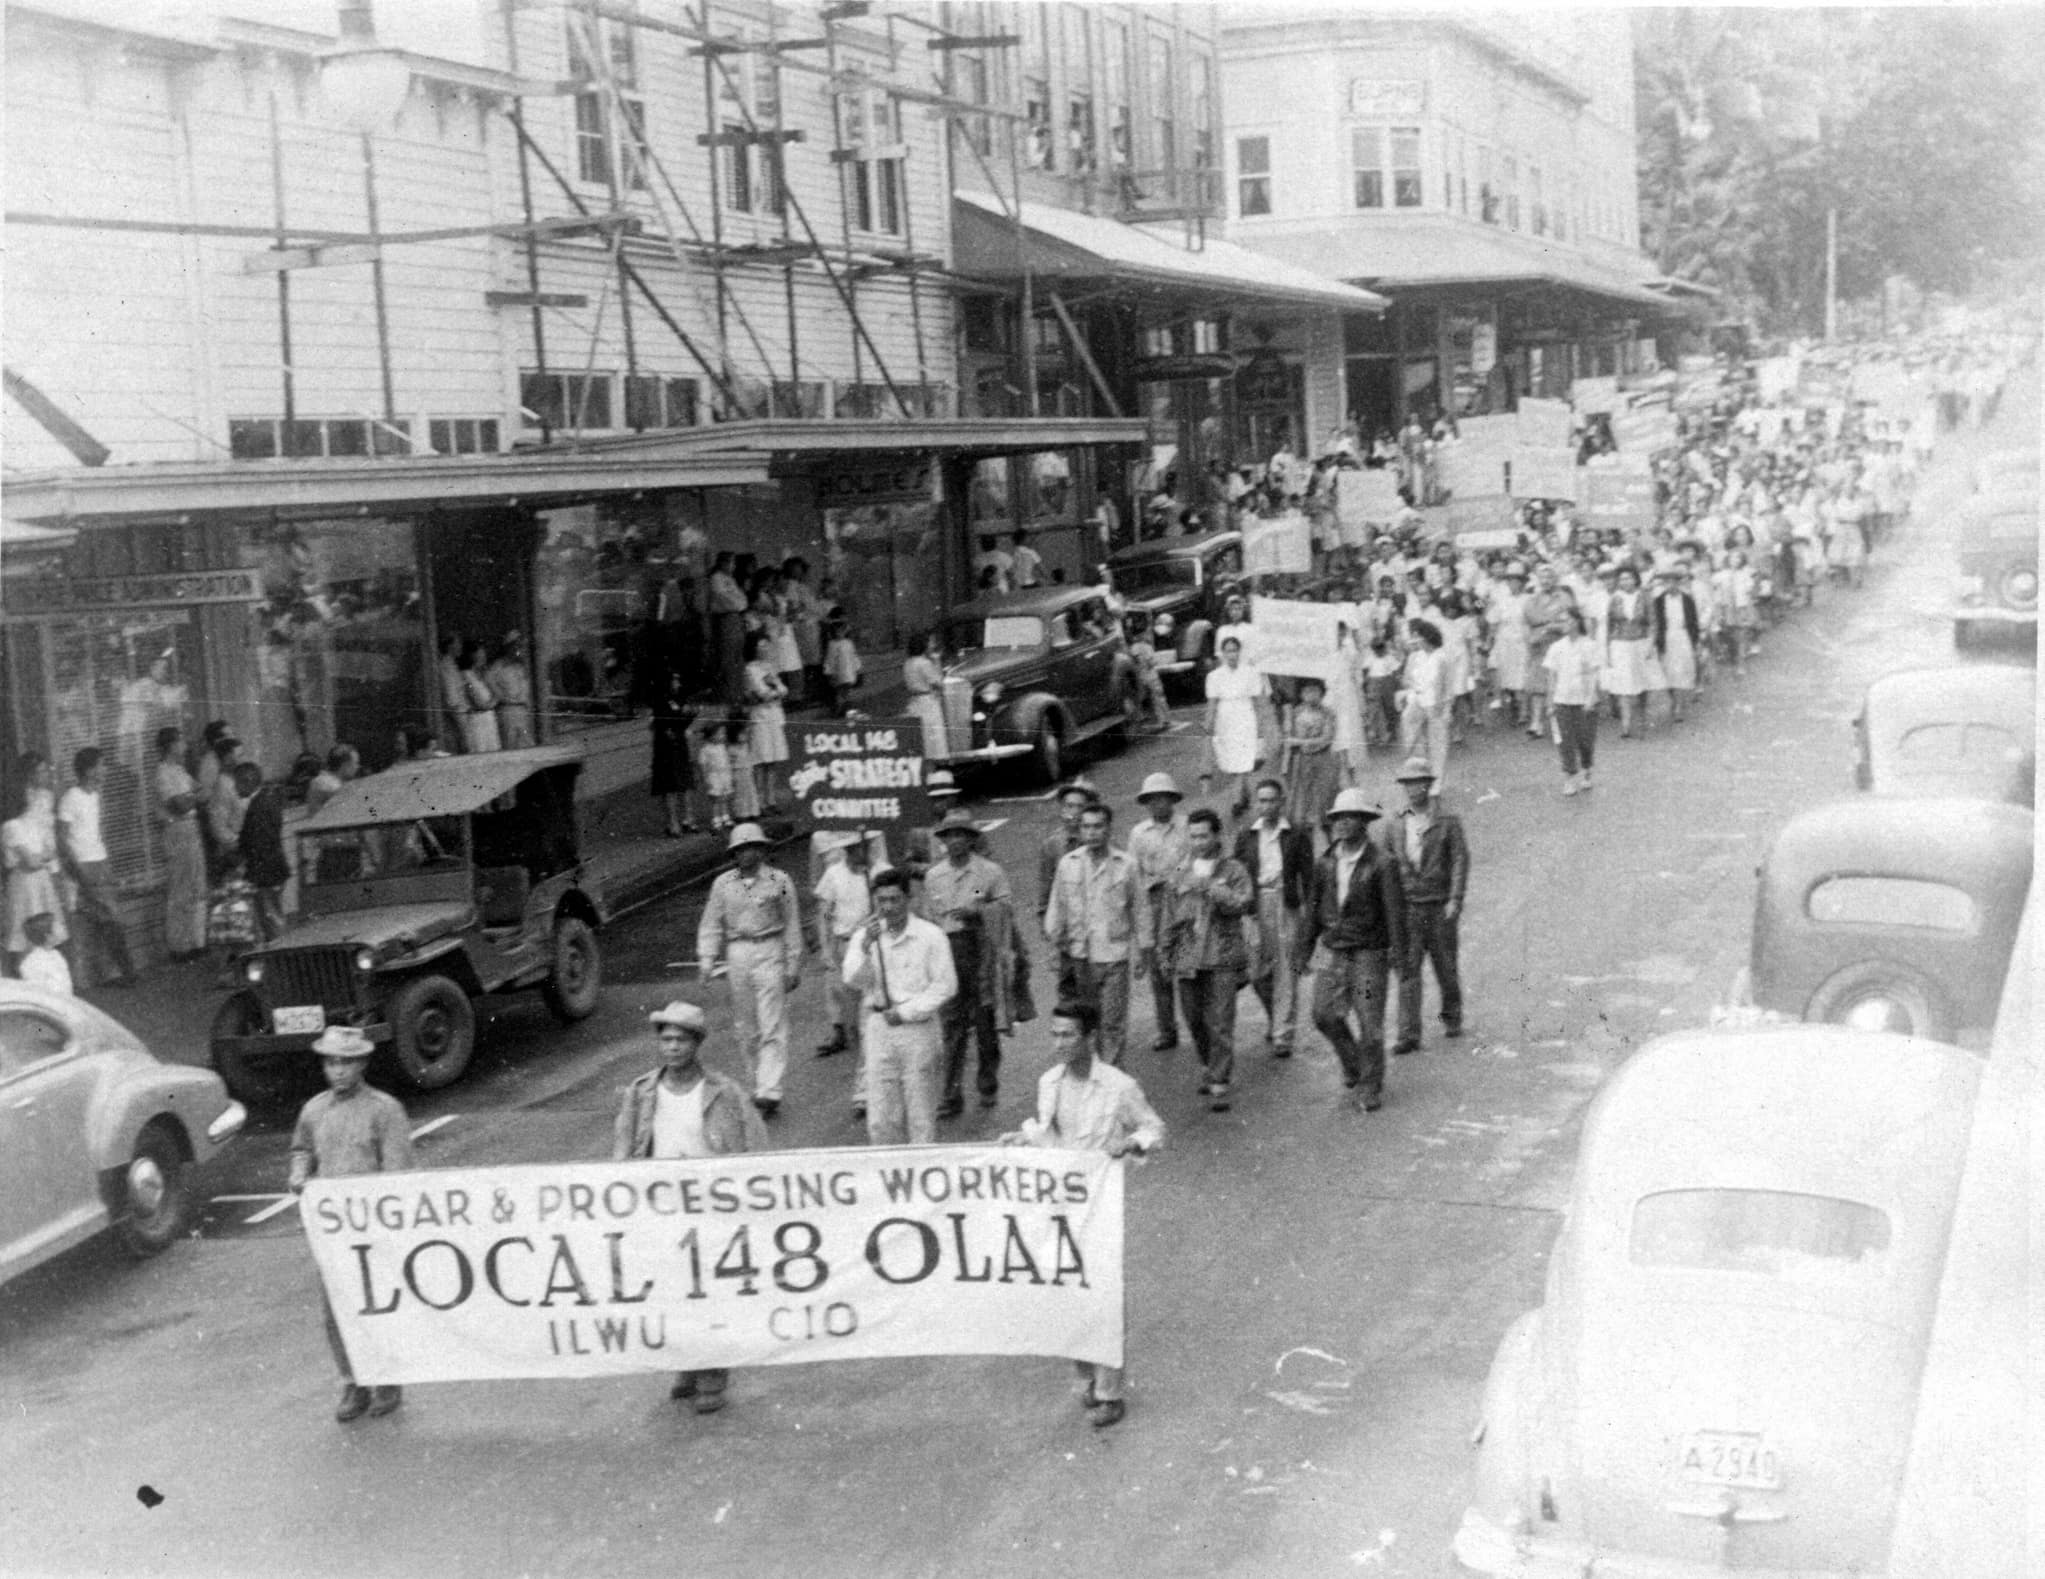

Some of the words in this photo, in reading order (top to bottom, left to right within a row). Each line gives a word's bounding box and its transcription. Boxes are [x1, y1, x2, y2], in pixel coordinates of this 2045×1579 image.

[804, 732, 863, 754] LOCAL
[865, 729, 898, 751] 148
[829, 756, 922, 789] STRATEGY
[811, 797, 901, 820] COMMITTEE
[317, 1188, 472, 1234] SUGAR
[490, 1186, 516, 1225] &
[538, 1170, 858, 1223] PROCESSING
[879, 1164, 1089, 1204] WORKERS
[350, 1231, 654, 1316] LOCAL
[678, 1220, 829, 1300] 148
[865, 1212, 1091, 1289] OLAA
[548, 1313, 666, 1357] ILWU
[768, 1301, 859, 1341] CIO
